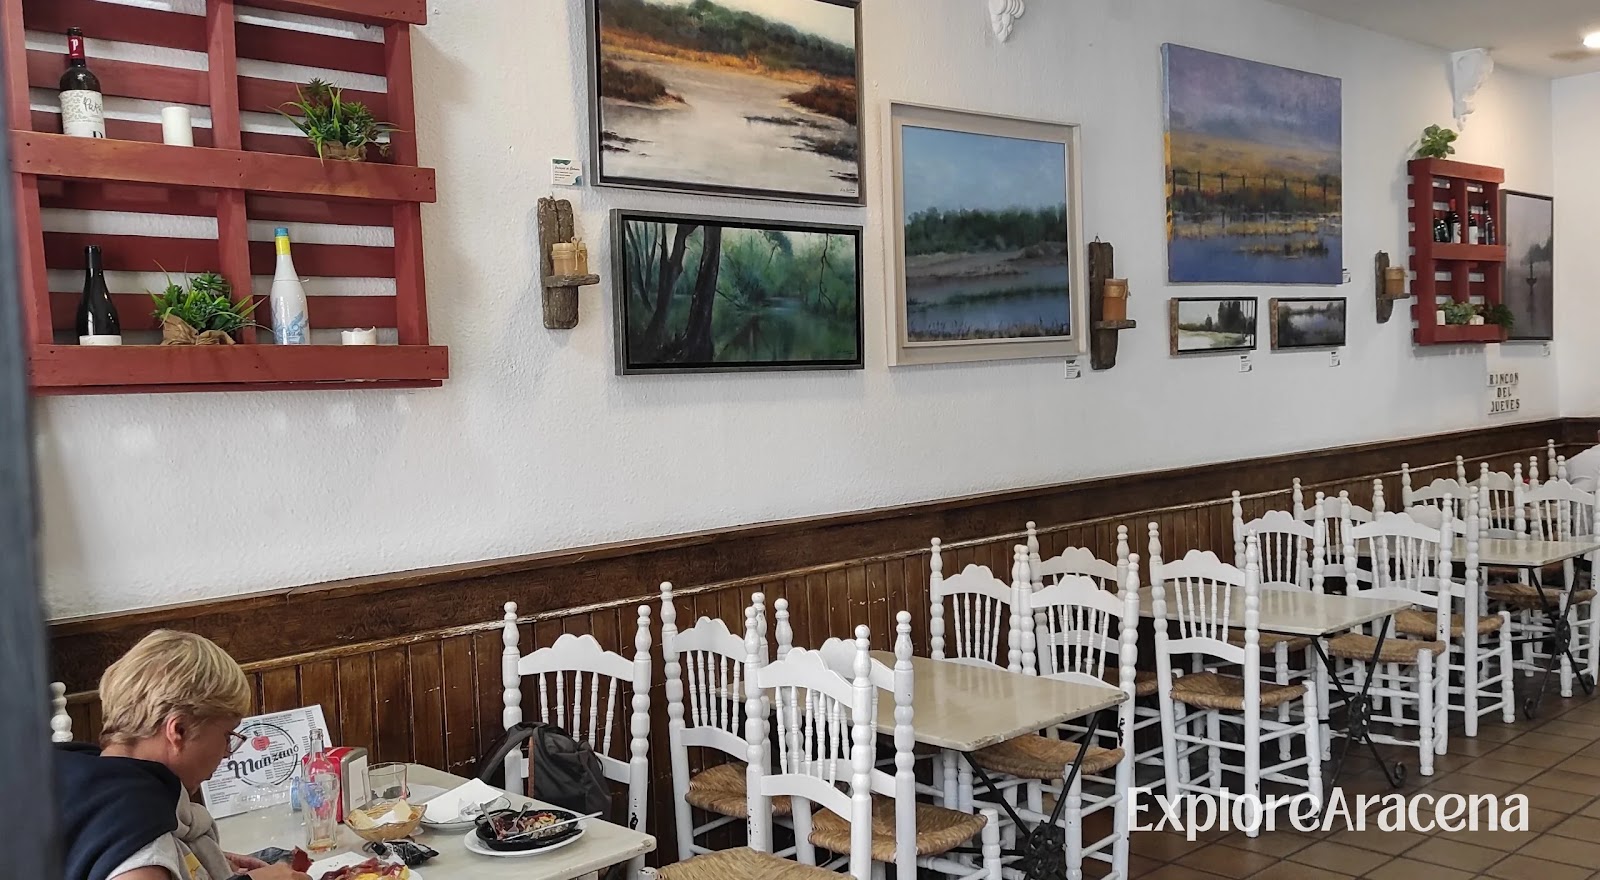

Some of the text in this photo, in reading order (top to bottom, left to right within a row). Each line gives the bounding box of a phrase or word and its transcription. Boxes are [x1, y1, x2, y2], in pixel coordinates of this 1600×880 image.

[1489, 372, 1519, 385] RINCON
[1497, 387, 1511, 398] DEL
[1490, 399, 1520, 412] JUEVES
[227, 743, 299, 779] Manzano
